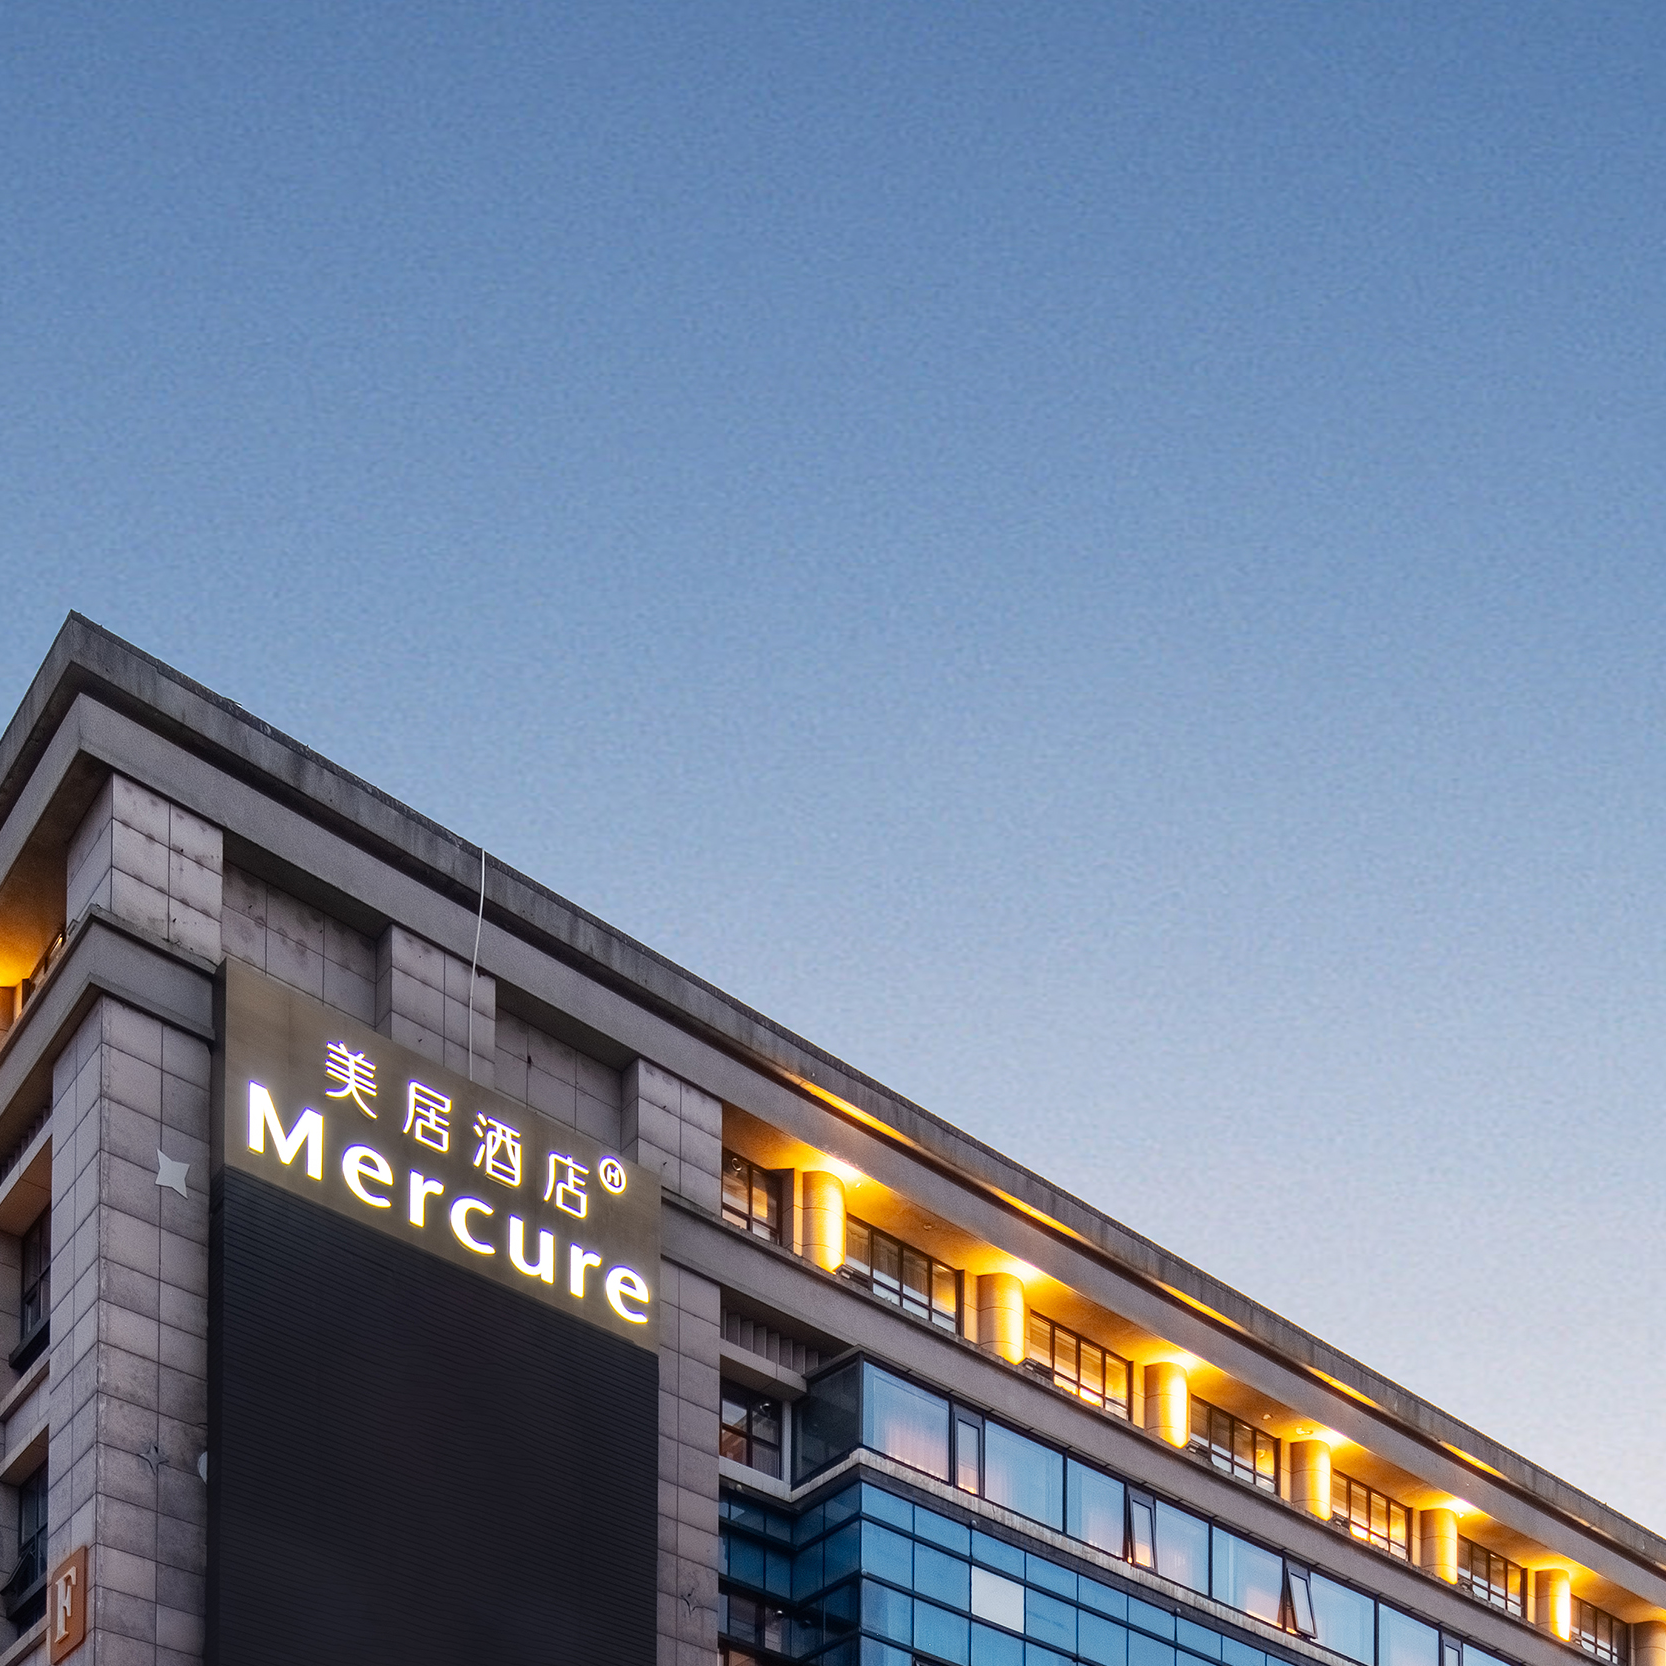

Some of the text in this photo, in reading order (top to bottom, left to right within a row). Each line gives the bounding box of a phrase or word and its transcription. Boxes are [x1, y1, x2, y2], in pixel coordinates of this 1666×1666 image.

[247, 1080, 651, 1325] Mercure
[324, 1040, 590, 1219] 美居酒店
